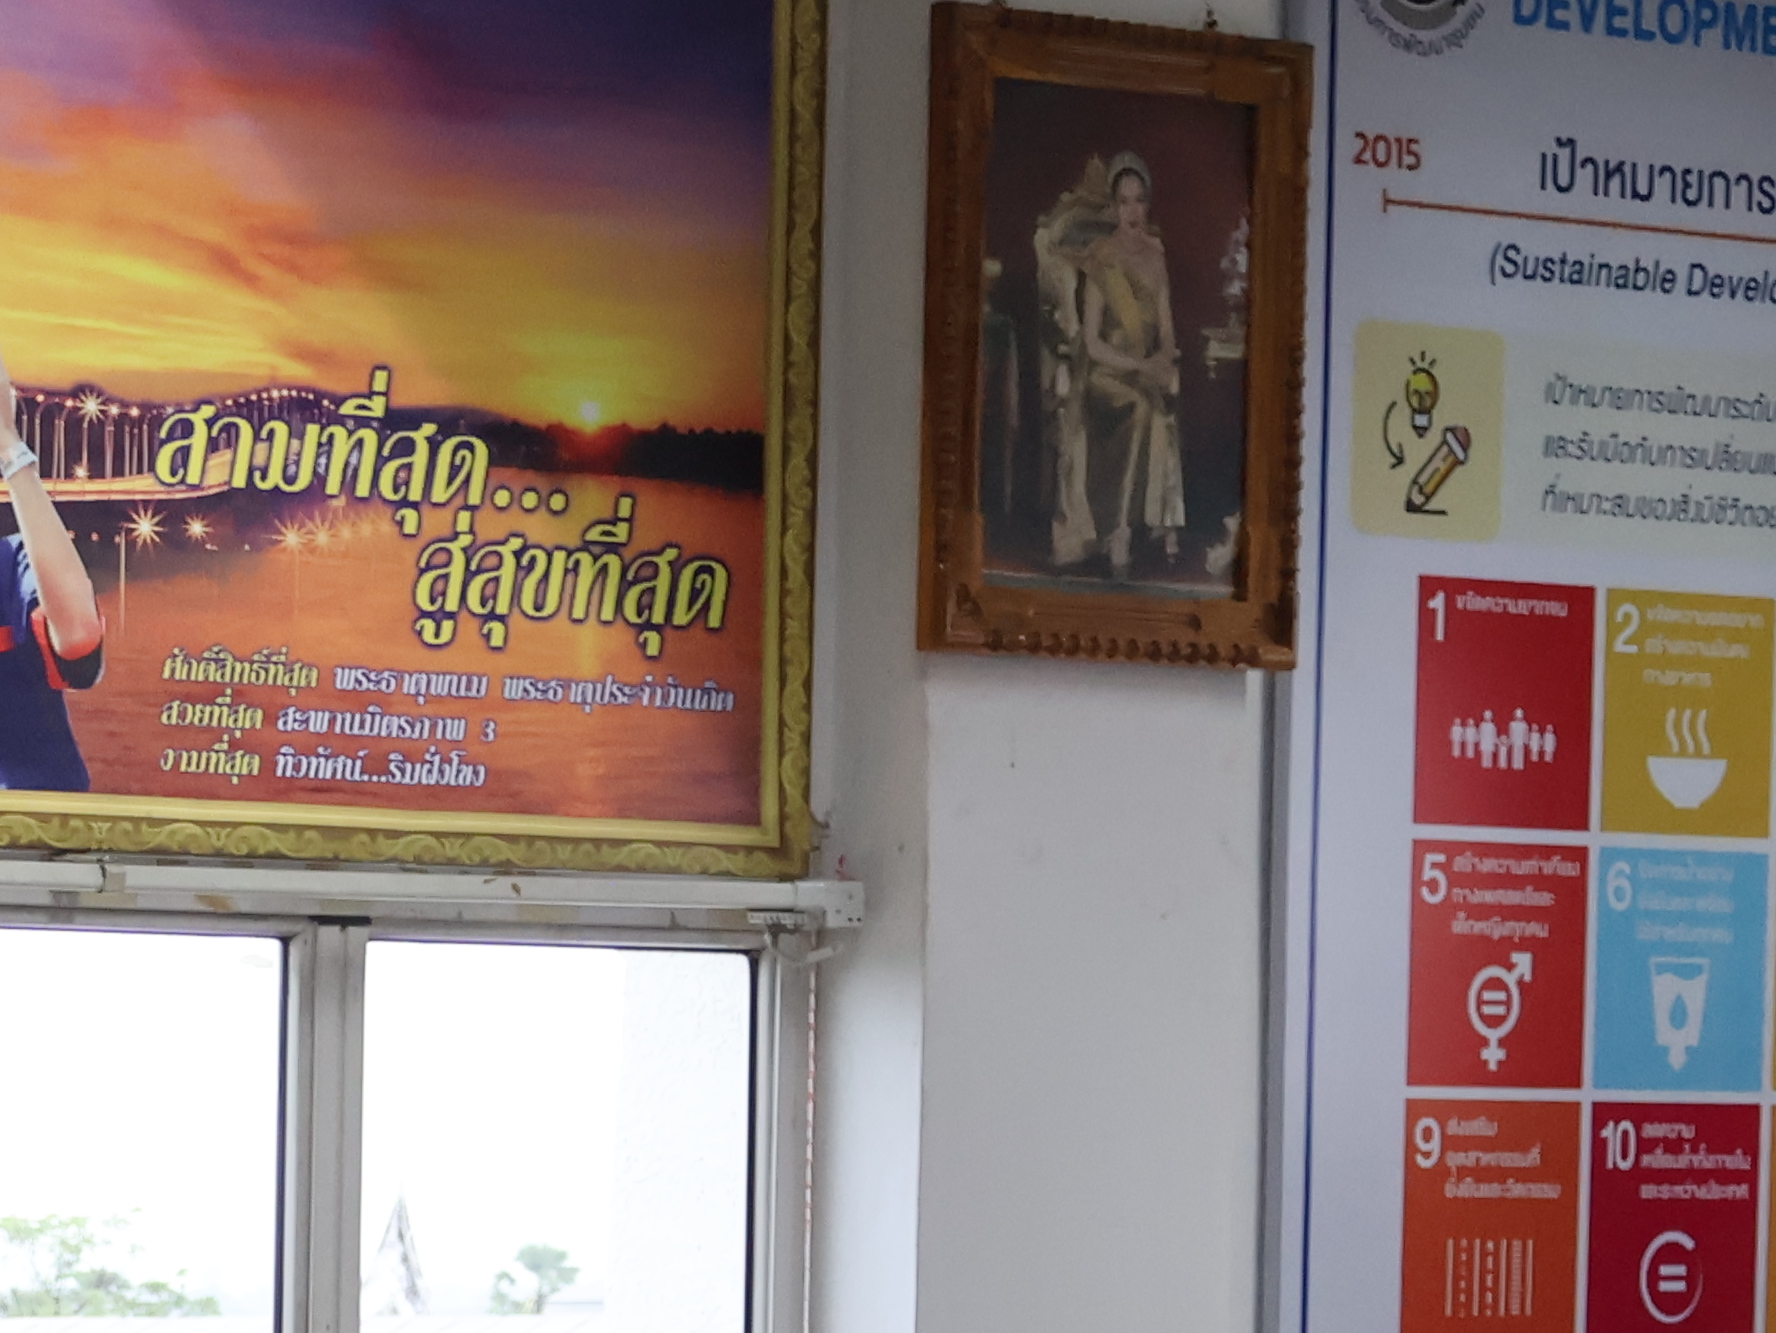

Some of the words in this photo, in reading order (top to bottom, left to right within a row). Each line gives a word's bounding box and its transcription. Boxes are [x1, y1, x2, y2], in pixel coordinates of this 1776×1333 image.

[1352, 131, 1422, 172] 2015
[1490, 240, 1677, 297] (Sustainable
[1427, 589, 1446, 643] 1
[1613, 602, 1642, 655] 2
[159, 686, 265, 740] สวยที่สุด
[480, 718, 497, 744] 3
[158, 732, 262, 787] งามที่สุด
[1419, 852, 1448, 905] 5
[1606, 860, 1633, 912] 6
[1413, 1116, 1443, 1169] 9
[1599, 1118, 1637, 1172] 10
